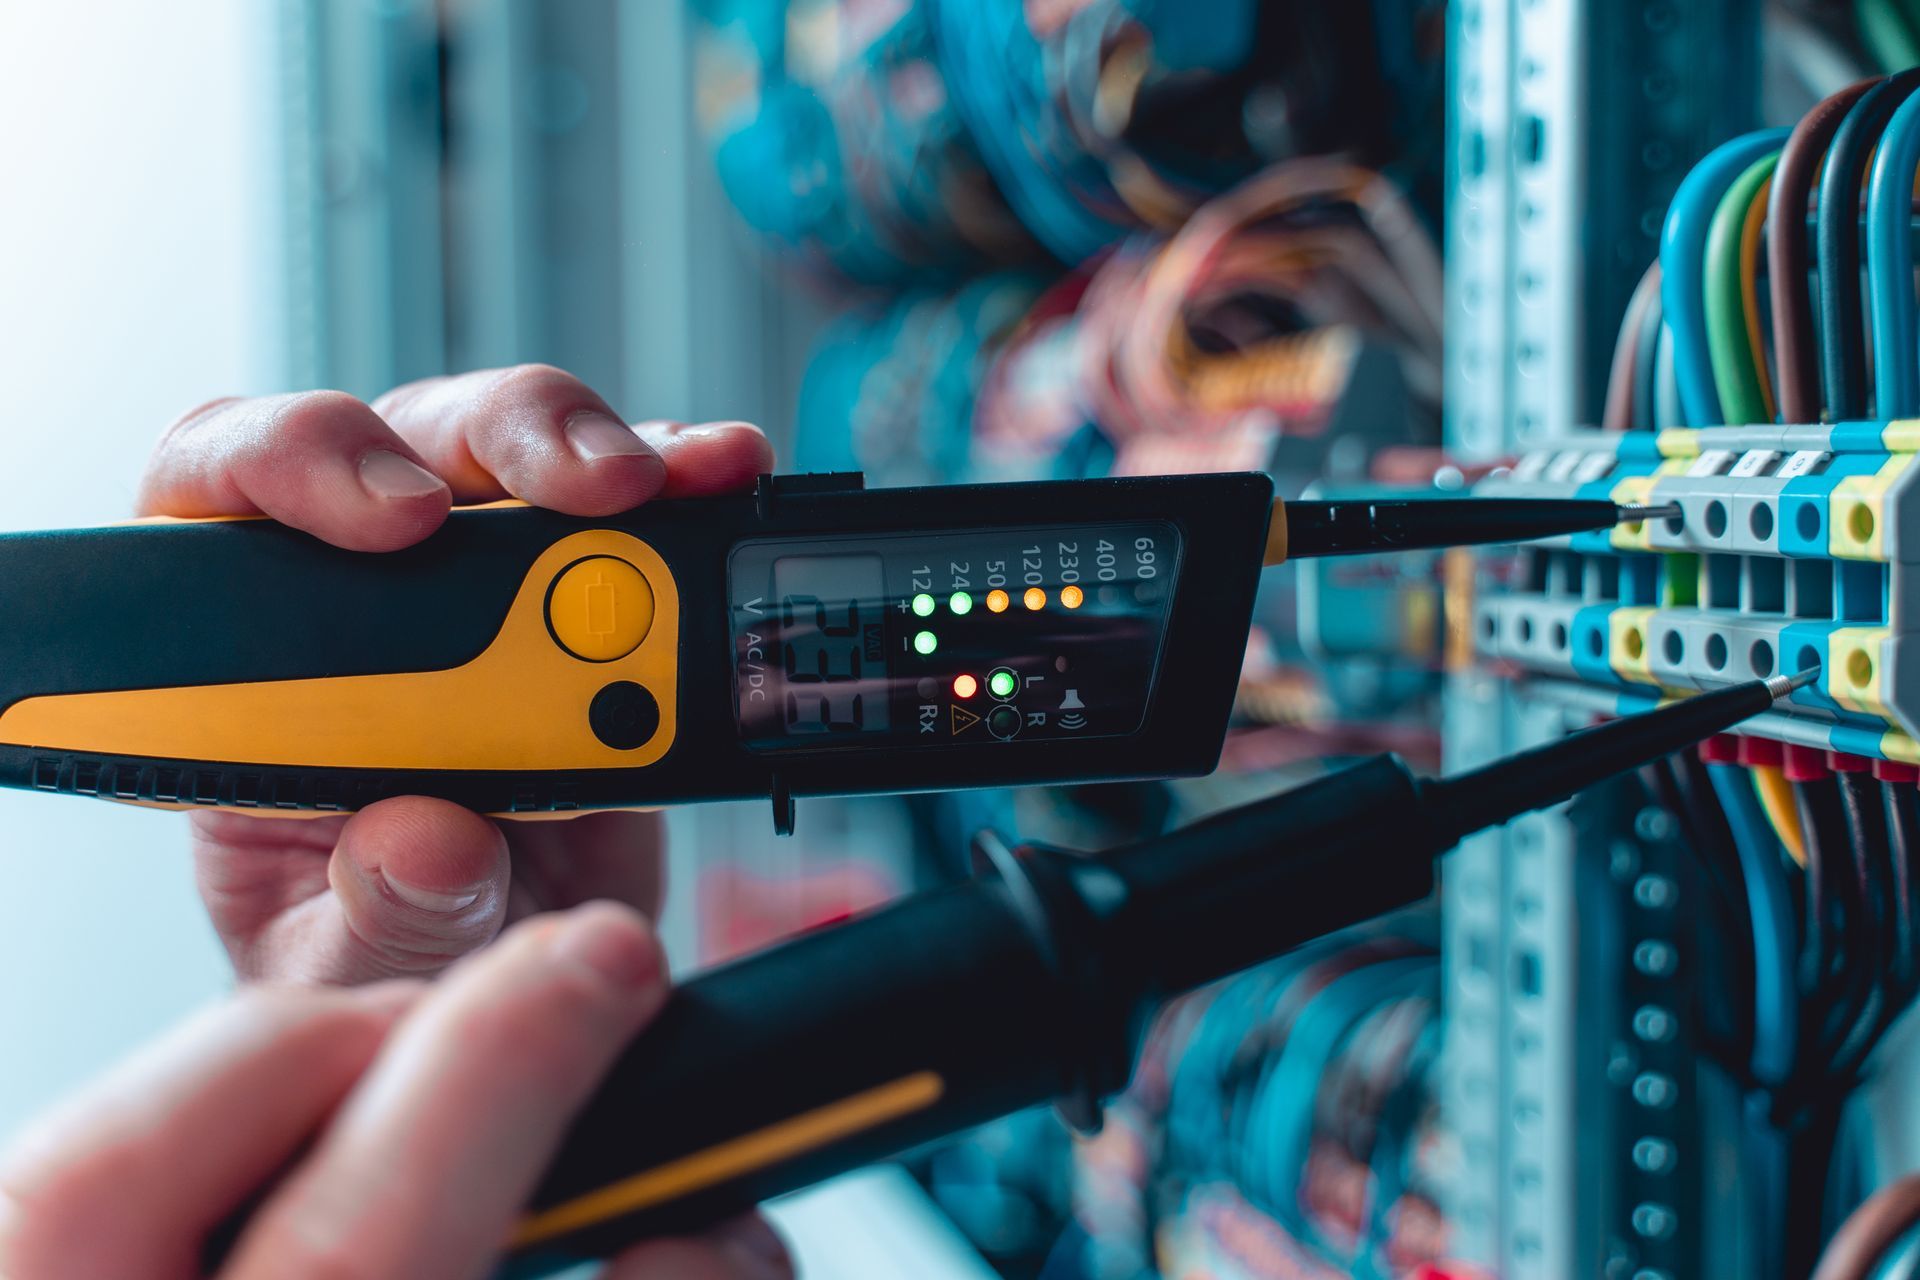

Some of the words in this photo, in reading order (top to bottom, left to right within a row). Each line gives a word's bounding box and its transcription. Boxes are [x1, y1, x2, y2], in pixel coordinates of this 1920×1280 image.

[1022, 544, 1043, 586] 120
[1058, 541, 1080, 584] 230
[1096, 538, 1117, 582] 400
[1134, 537, 1157, 580] 690
[912, 565, 932, 591] 12
[950, 562, 970, 590] 24
[986, 560, 1007, 588] 50
[742, 597, 763, 615] V
[746, 631, 765, 702] AC/DC
[783, 594, 864, 732] 233
[1026, 676, 1045, 689] L
[919, 705, 938, 734] Rx
[1027, 712, 1046, 727] R
